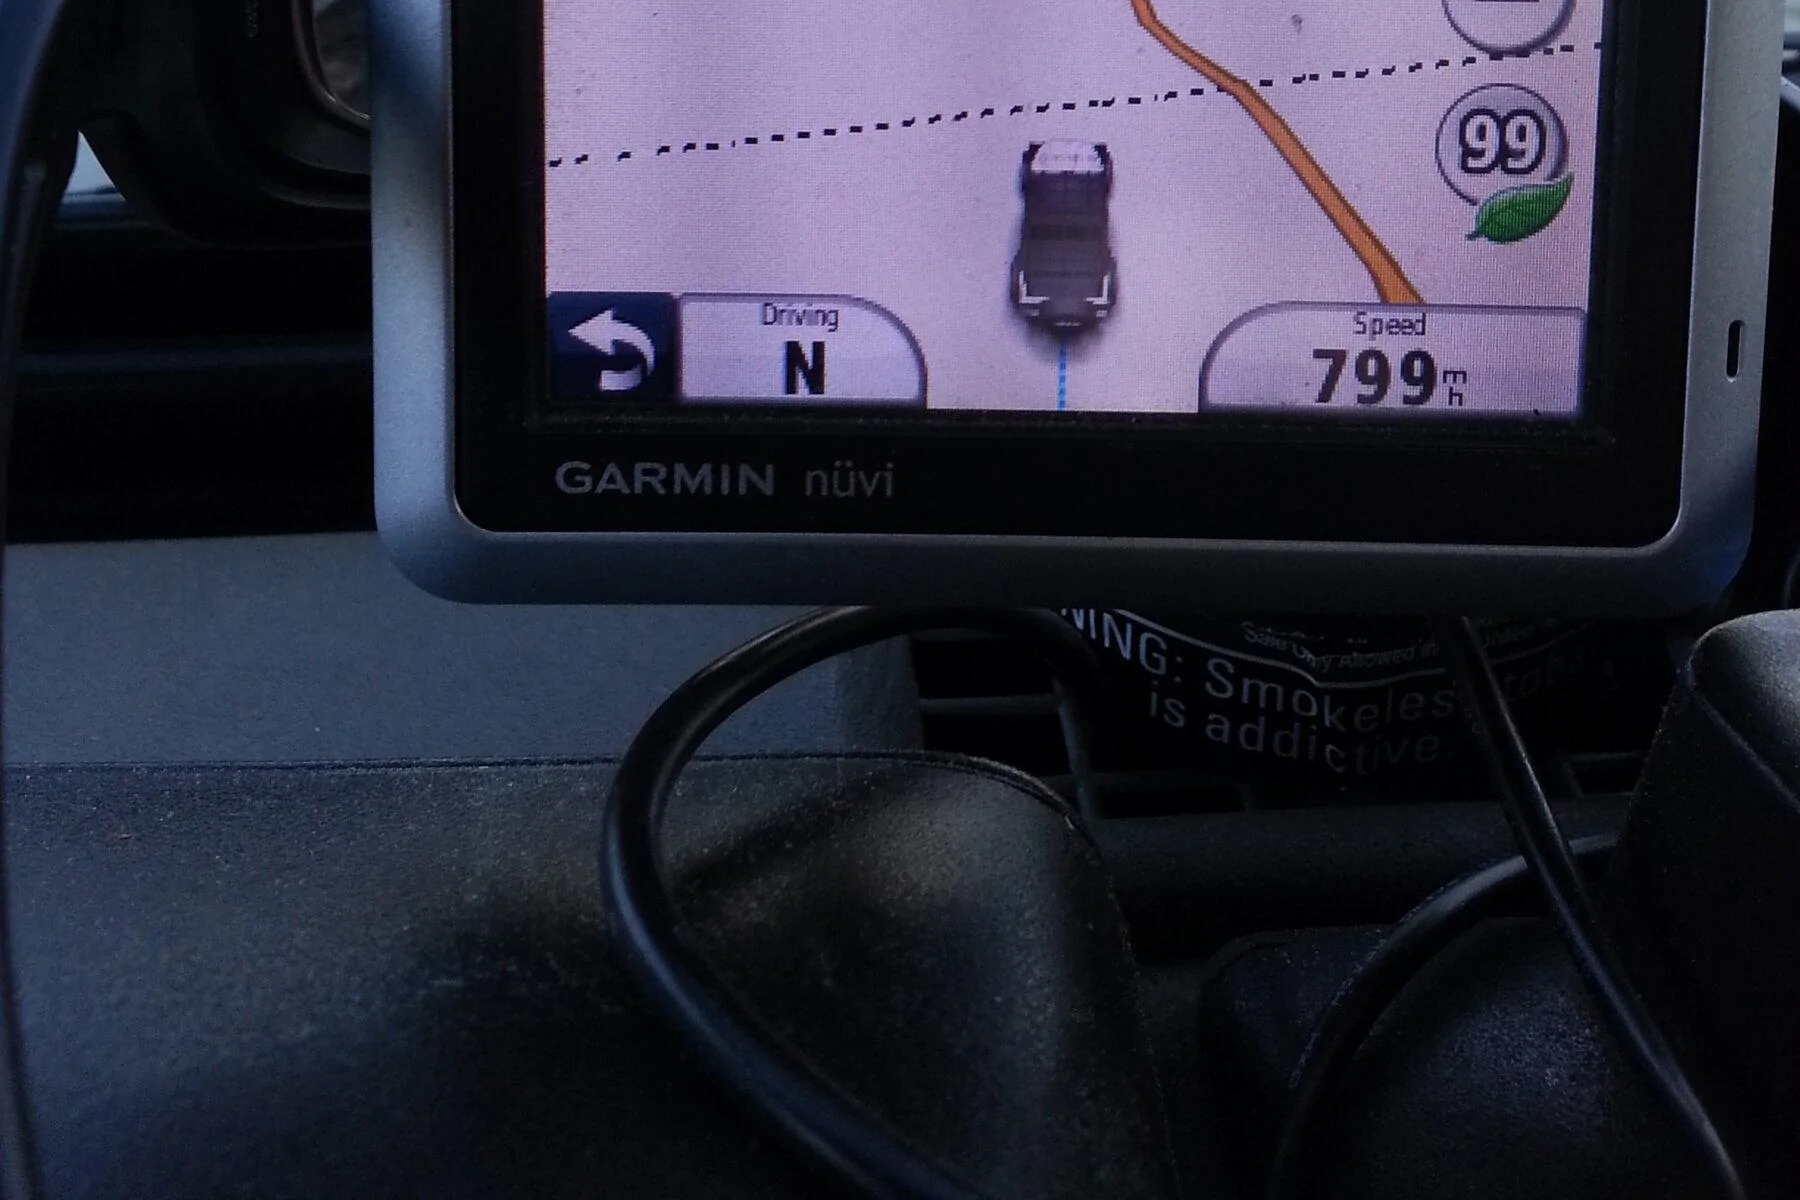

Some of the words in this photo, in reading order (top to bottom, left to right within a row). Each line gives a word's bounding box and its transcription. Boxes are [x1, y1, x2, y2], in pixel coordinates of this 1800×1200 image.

[1457, 106, 1546, 176] 99
[761, 301, 839, 333] Driving
[1352, 310, 1426, 340] Speed
[785, 339, 826, 395] N
[1311, 347, 1438, 406] 799
[553, 459, 776, 497] GARMIN
[804, 458, 896, 499] nüvi
[1148, 678, 1188, 730] is
[1203, 655, 1457, 735] Smokeles
